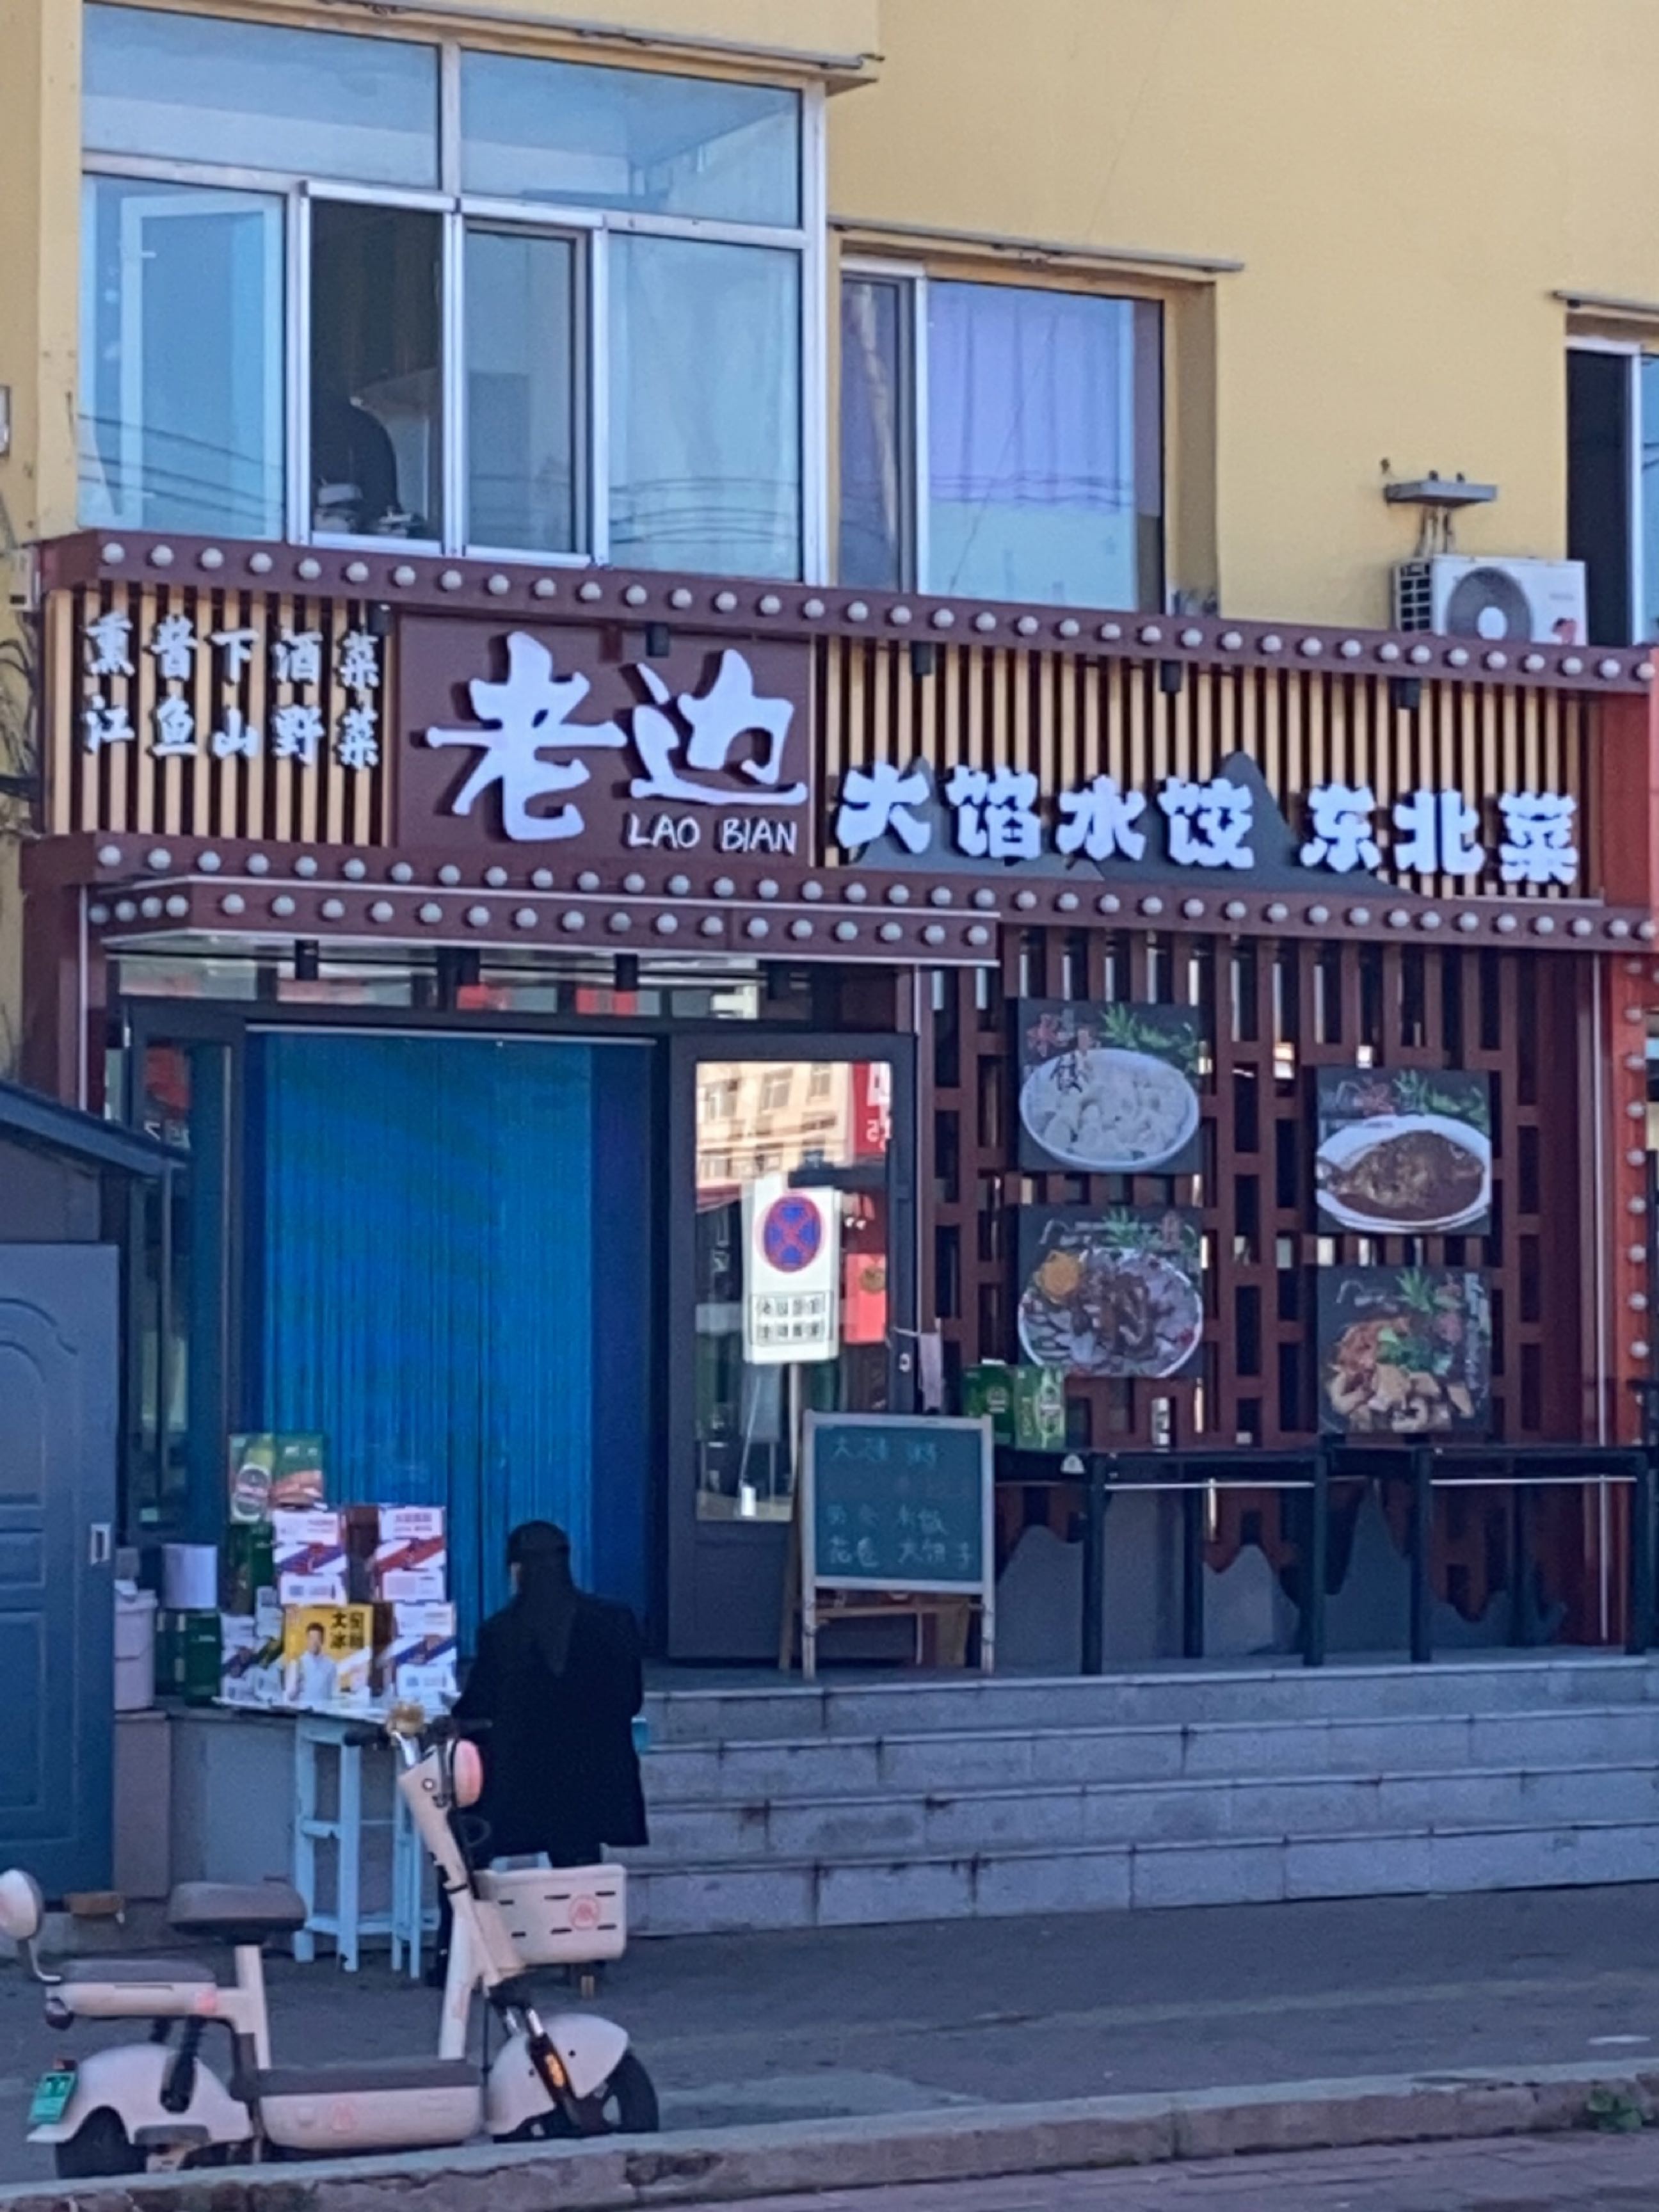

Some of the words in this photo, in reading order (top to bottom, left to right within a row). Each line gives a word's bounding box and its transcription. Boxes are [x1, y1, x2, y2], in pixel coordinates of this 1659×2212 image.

[84, 693, 380, 770] 江鱼山野菜
[426, 630, 808, 841] 老边
[627, 813, 701, 849] LAO
[721, 817, 797, 856] BIAN
[835, 759, 1255, 870] 大馅水饺
[1299, 782, 1579, 885] 东北菜
